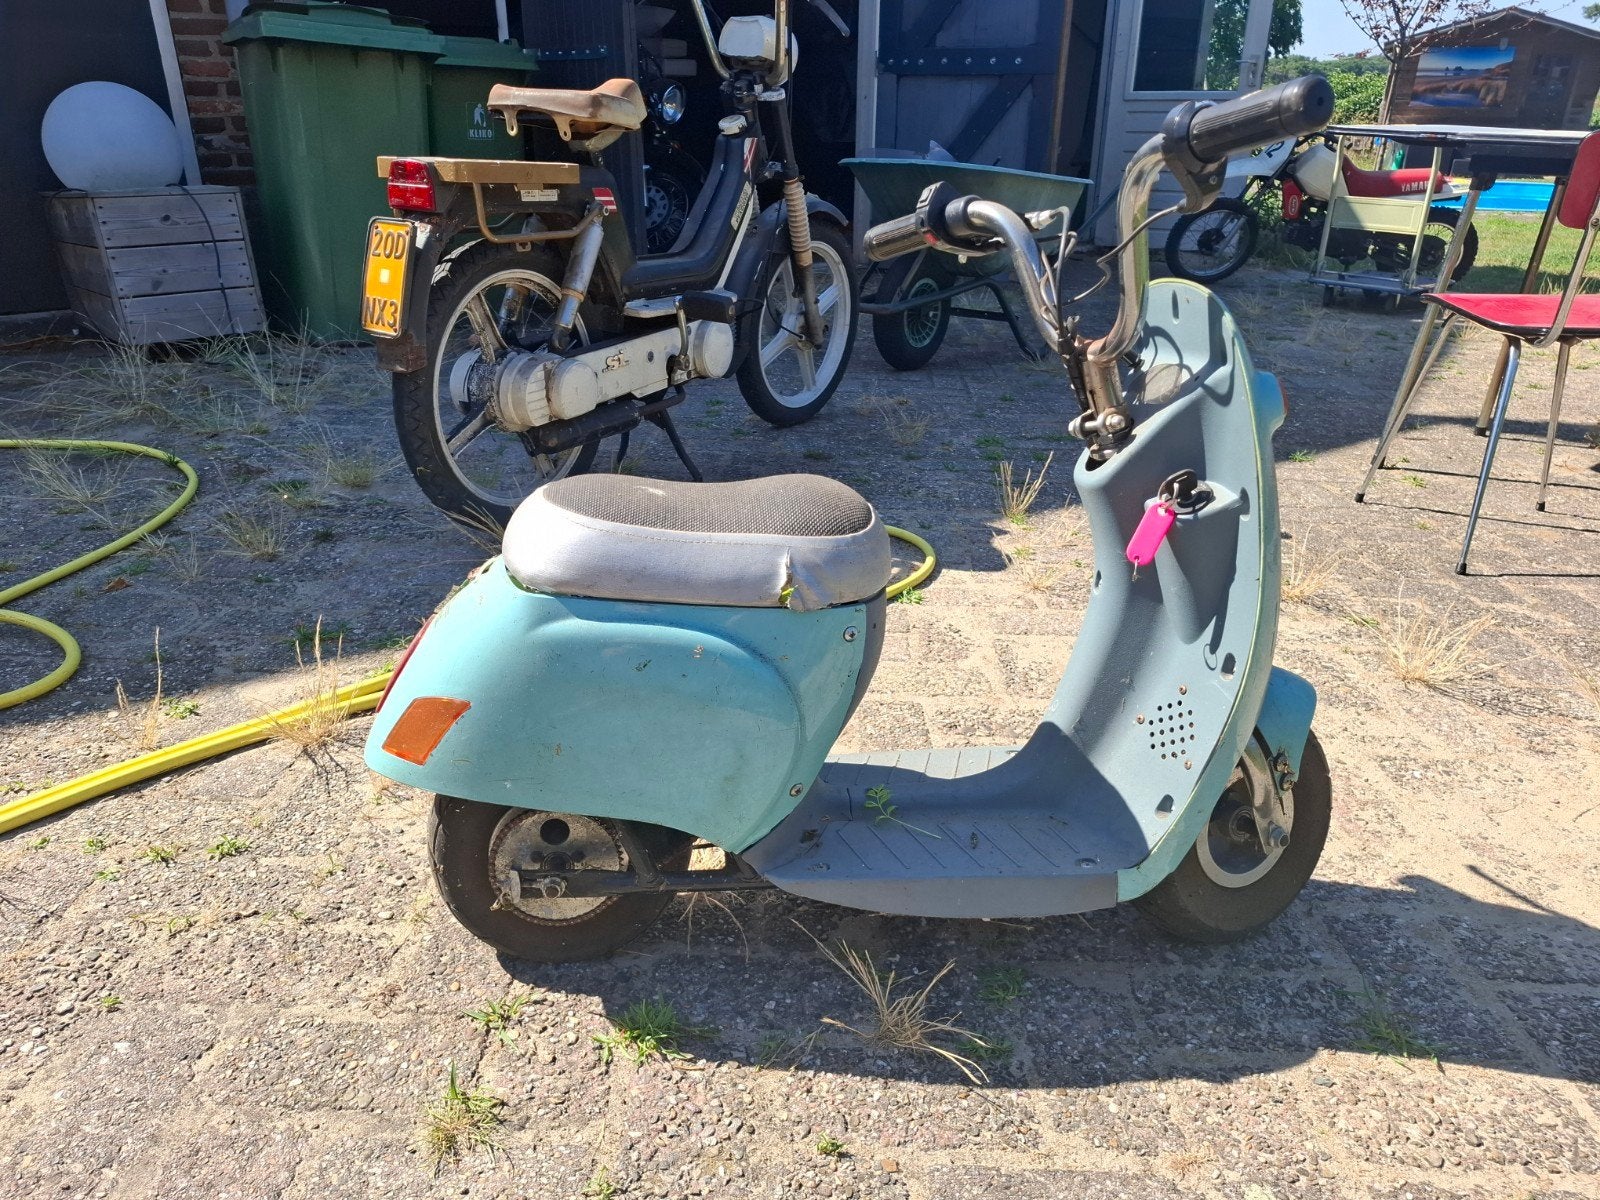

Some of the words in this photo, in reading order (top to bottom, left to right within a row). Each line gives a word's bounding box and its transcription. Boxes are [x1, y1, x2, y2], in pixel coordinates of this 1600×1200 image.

[469, 129, 493, 138] KLIKO
[1401, 181, 1430, 192] YAMAH
[372, 229, 407, 260] 20D
[363, 296, 398, 328] NX3
